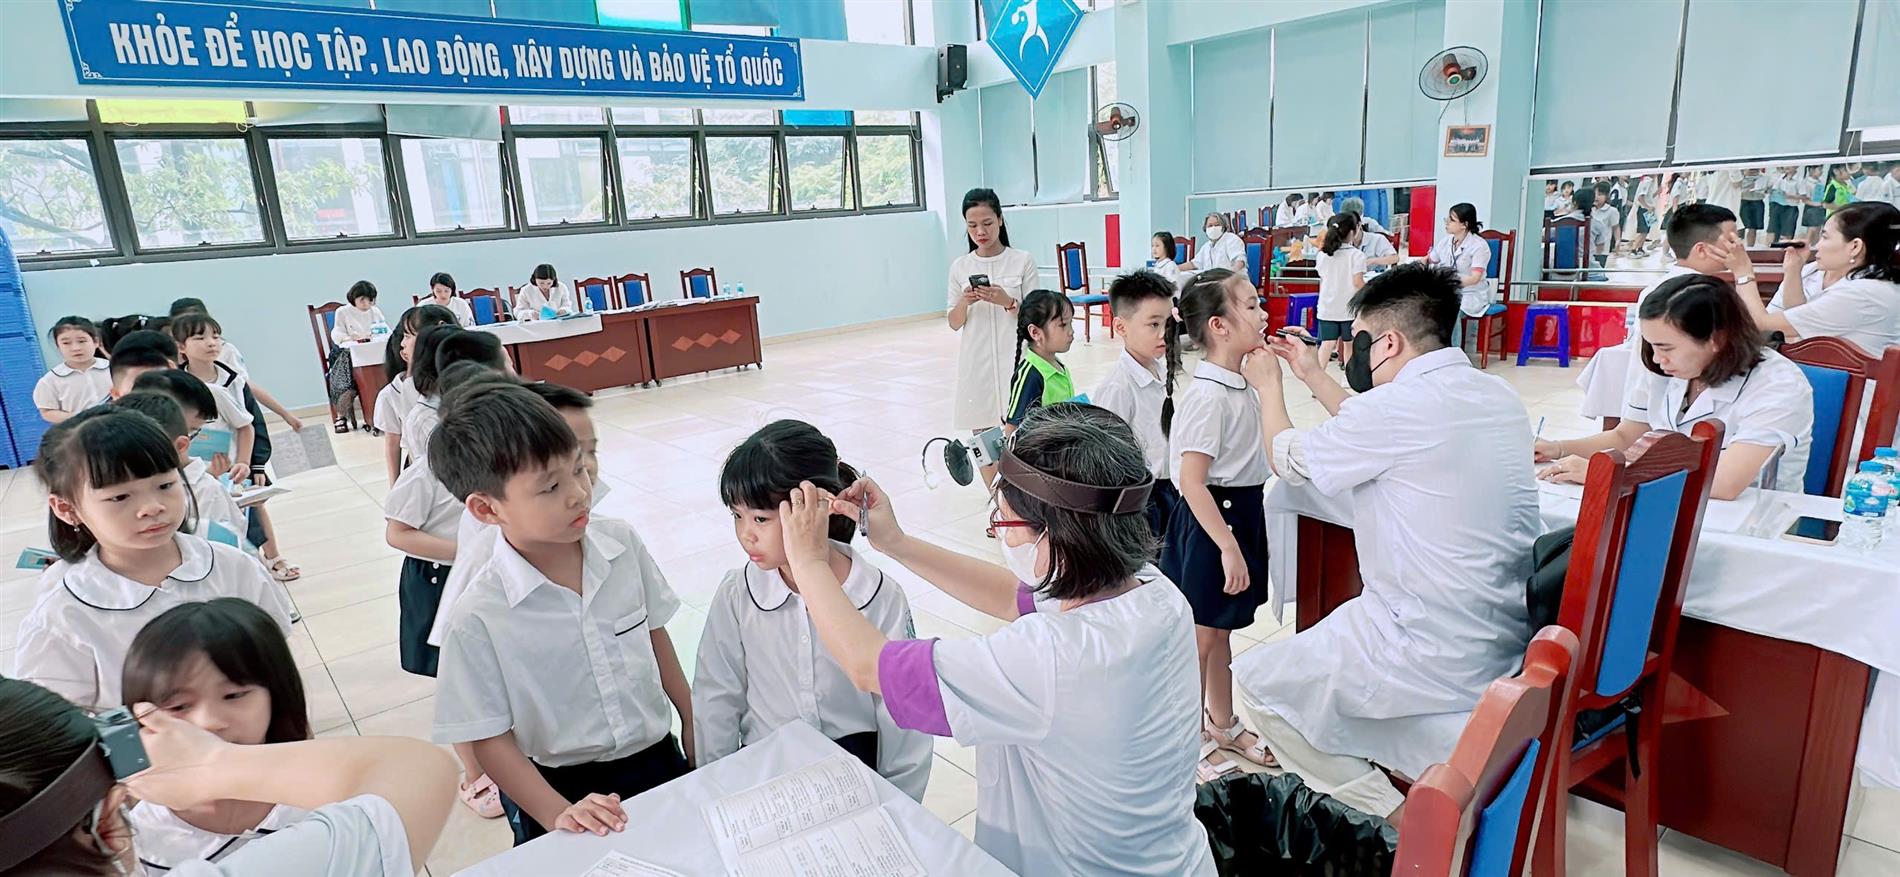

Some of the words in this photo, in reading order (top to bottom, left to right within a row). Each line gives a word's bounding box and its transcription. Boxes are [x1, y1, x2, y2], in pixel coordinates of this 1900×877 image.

[109, 12, 199, 66] KHỎE
[204, 11, 248, 68] ĐỂ
[251, 29, 312, 77] HỌC
[317, 26, 378, 79] TẬP,
[382, 37, 431, 75] LAO
[436, 34, 509, 83] ĐỘNG,
[512, 38, 553, 78] XÂY
[560, 44, 613, 86] DỰNG
[619, 43, 645, 81] VÀ
[649, 43, 686, 83] BẢO
[689, 48, 713, 89] VỆ
[715, 43, 737, 85] TỔ
[741, 46, 784, 86] QUỐC
